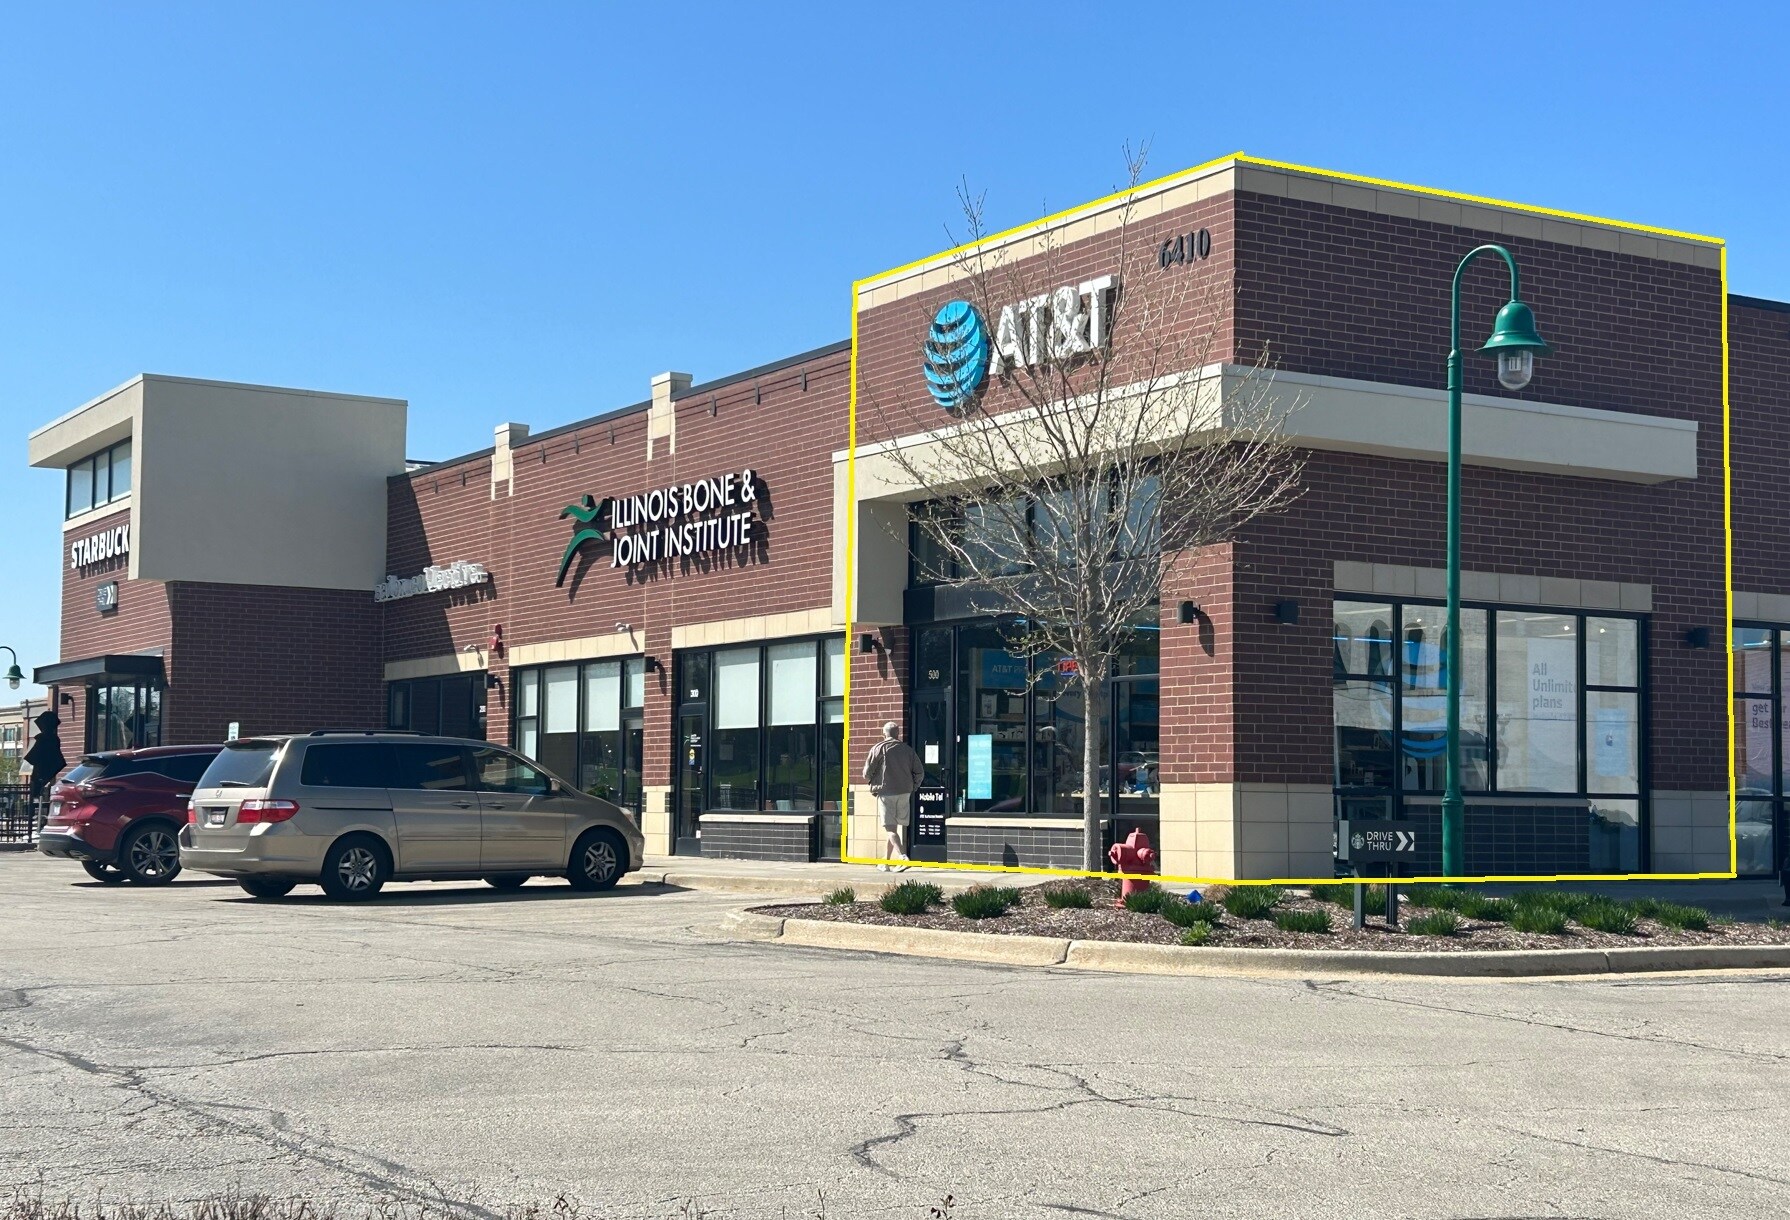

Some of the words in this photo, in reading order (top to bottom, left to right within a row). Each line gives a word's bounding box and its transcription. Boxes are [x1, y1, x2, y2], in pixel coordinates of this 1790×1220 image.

[1158, 228, 1211, 271] 6410
[988, 275, 1116, 375] AT&T
[611, 486, 679, 530] ILLINOIS
[683, 473, 735, 515] BONE
[741, 469, 756, 503] &
[71, 524, 130, 569] STARBUCK
[610, 530, 660, 568] JOINT
[664, 512, 751, 558] INSTITUTE
[928, 669, 940, 680] 500
[1532, 662, 1547, 676] All
[1532, 695, 1563, 711] plans
[1752, 703, 1769, 716] get
[1366, 831, 1393, 841] DRIVE
[1367, 842, 1392, 851] THRU
